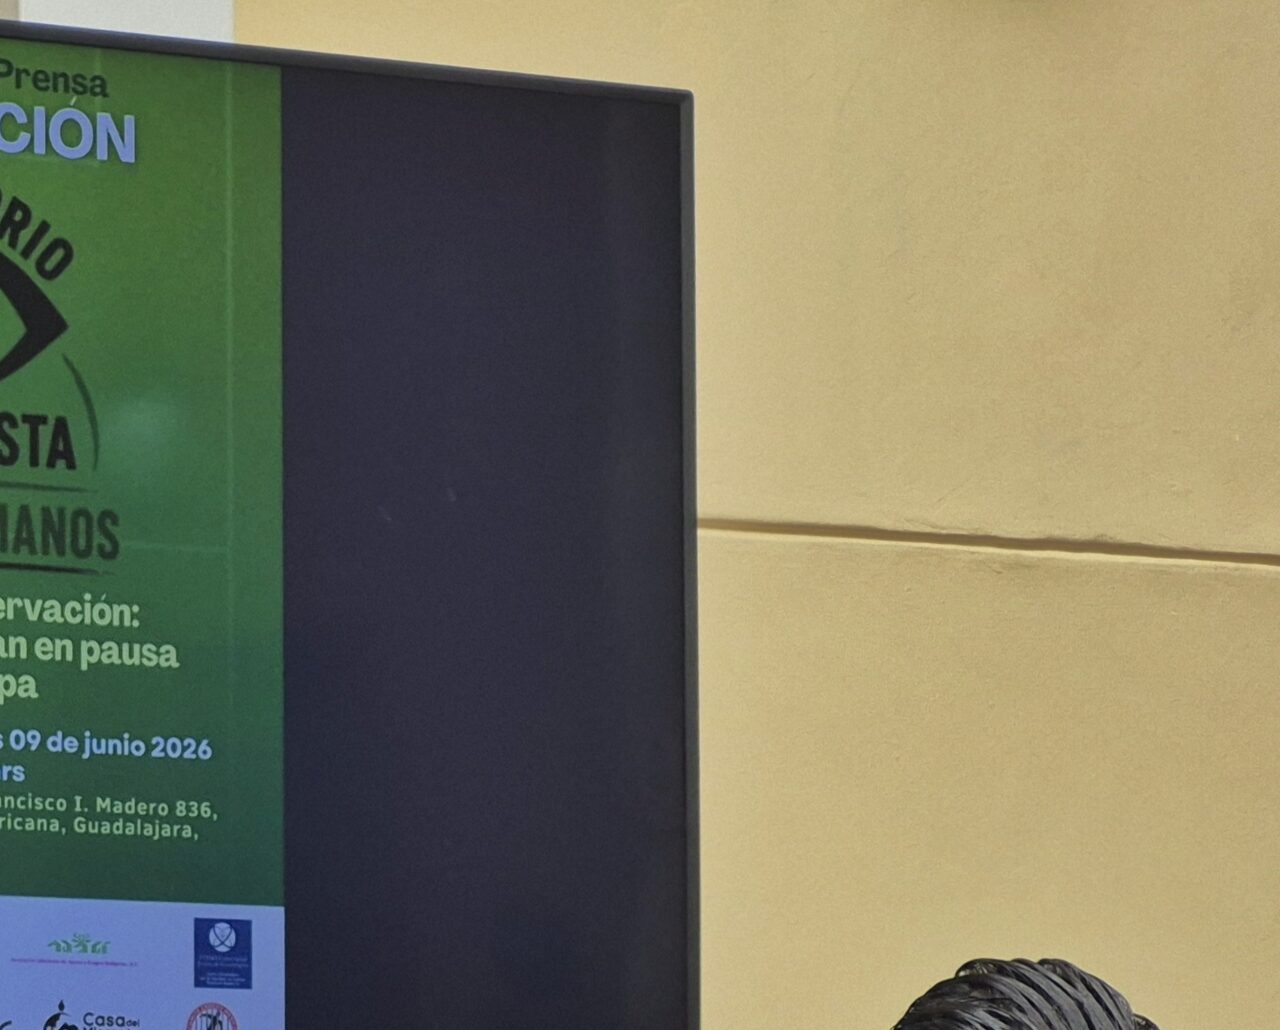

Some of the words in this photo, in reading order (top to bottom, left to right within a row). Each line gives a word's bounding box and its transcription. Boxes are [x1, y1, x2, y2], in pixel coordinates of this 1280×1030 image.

[34, 636, 73, 662] en
[80, 638, 180, 671] pausa
[9, 729, 41, 752] 09
[46, 730, 79, 753] de
[82, 730, 146, 760] junio
[150, 736, 213, 760] 2026
[73, 794, 89, 813] I.
[95, 796, 169, 818] Madero
[175, 800, 219, 822] 836,
[73, 815, 200, 842] Guadalajara,
[83, 1011, 125, 1027] Casa
